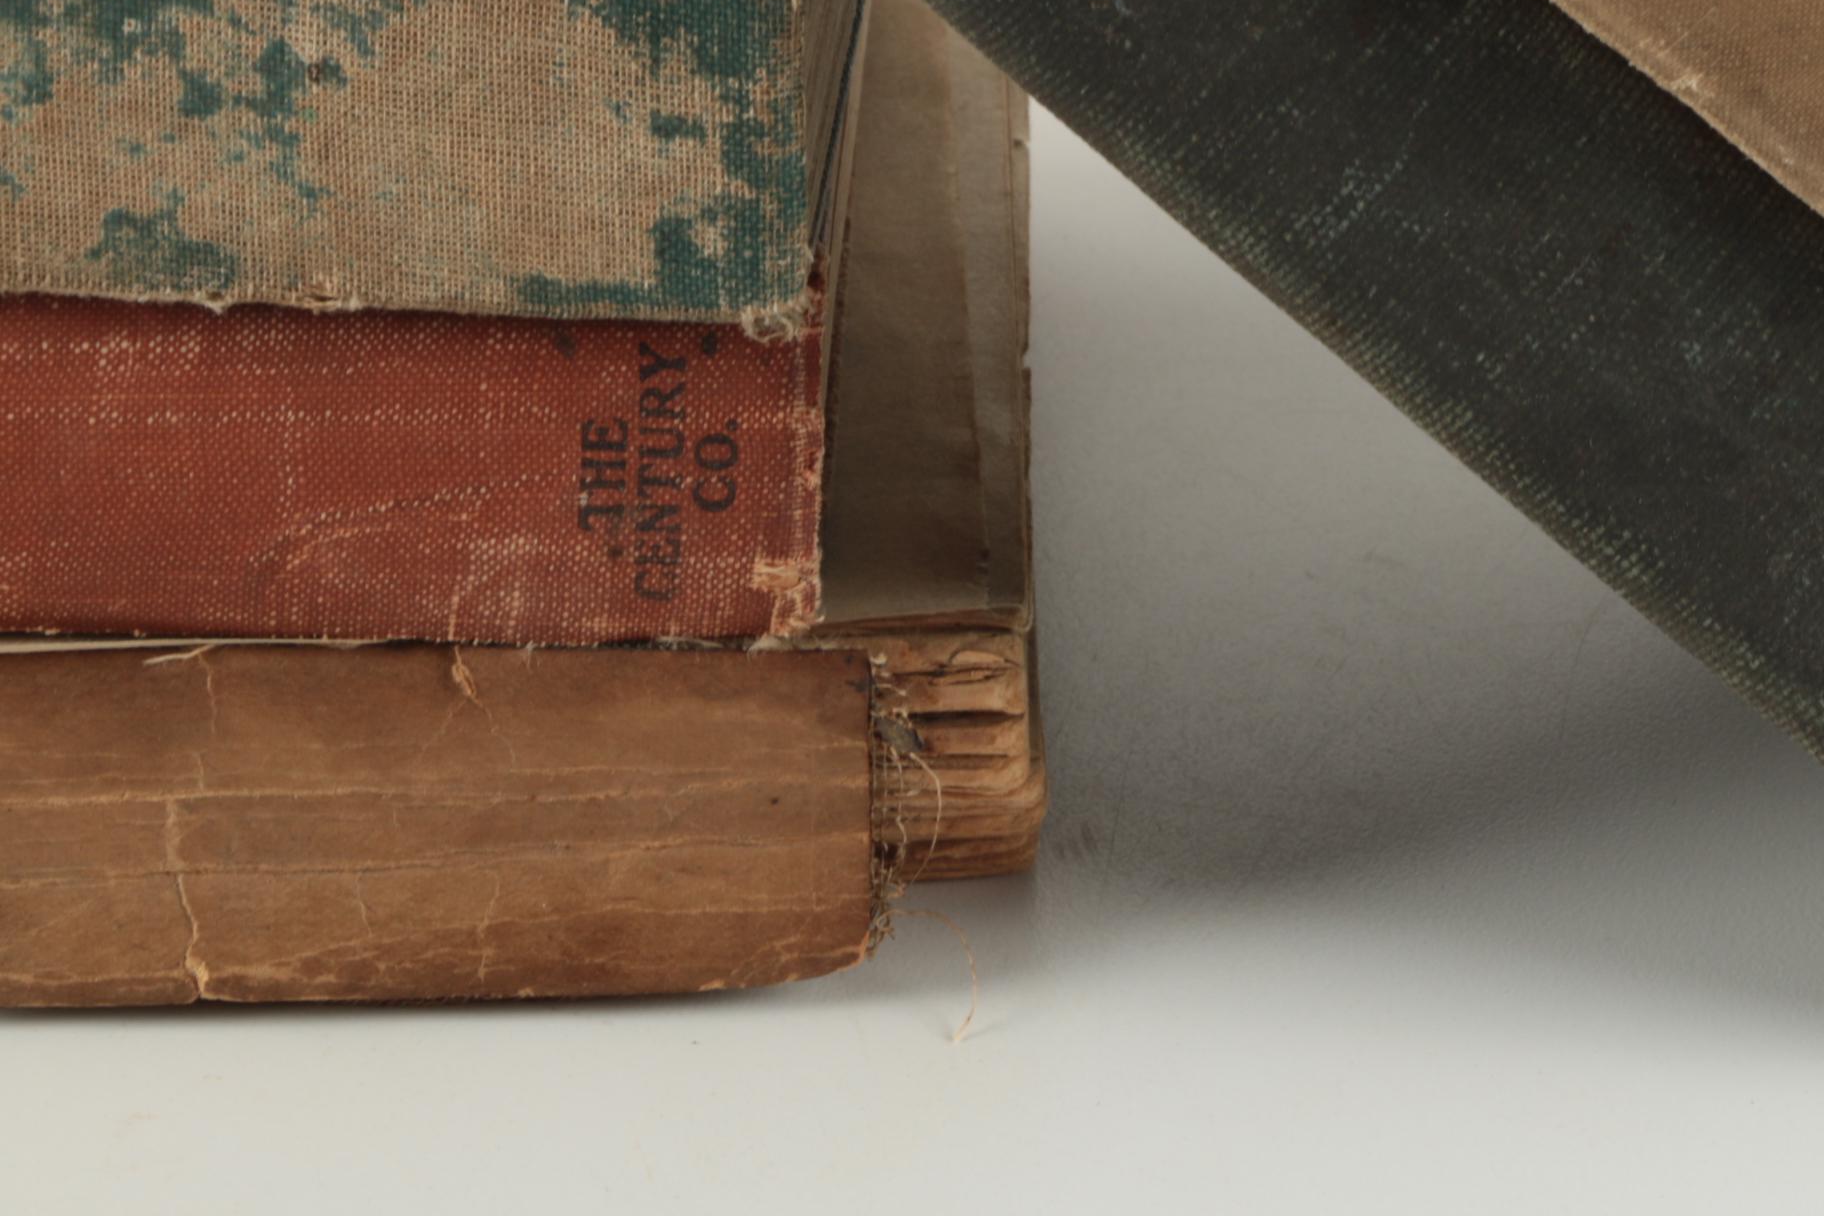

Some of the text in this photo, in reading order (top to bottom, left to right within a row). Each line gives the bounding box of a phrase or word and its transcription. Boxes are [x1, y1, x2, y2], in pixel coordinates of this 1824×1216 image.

[578, 417, 629, 532] THE
[634, 342, 687, 602] CENTURY
[693, 418, 739, 513] CO.
